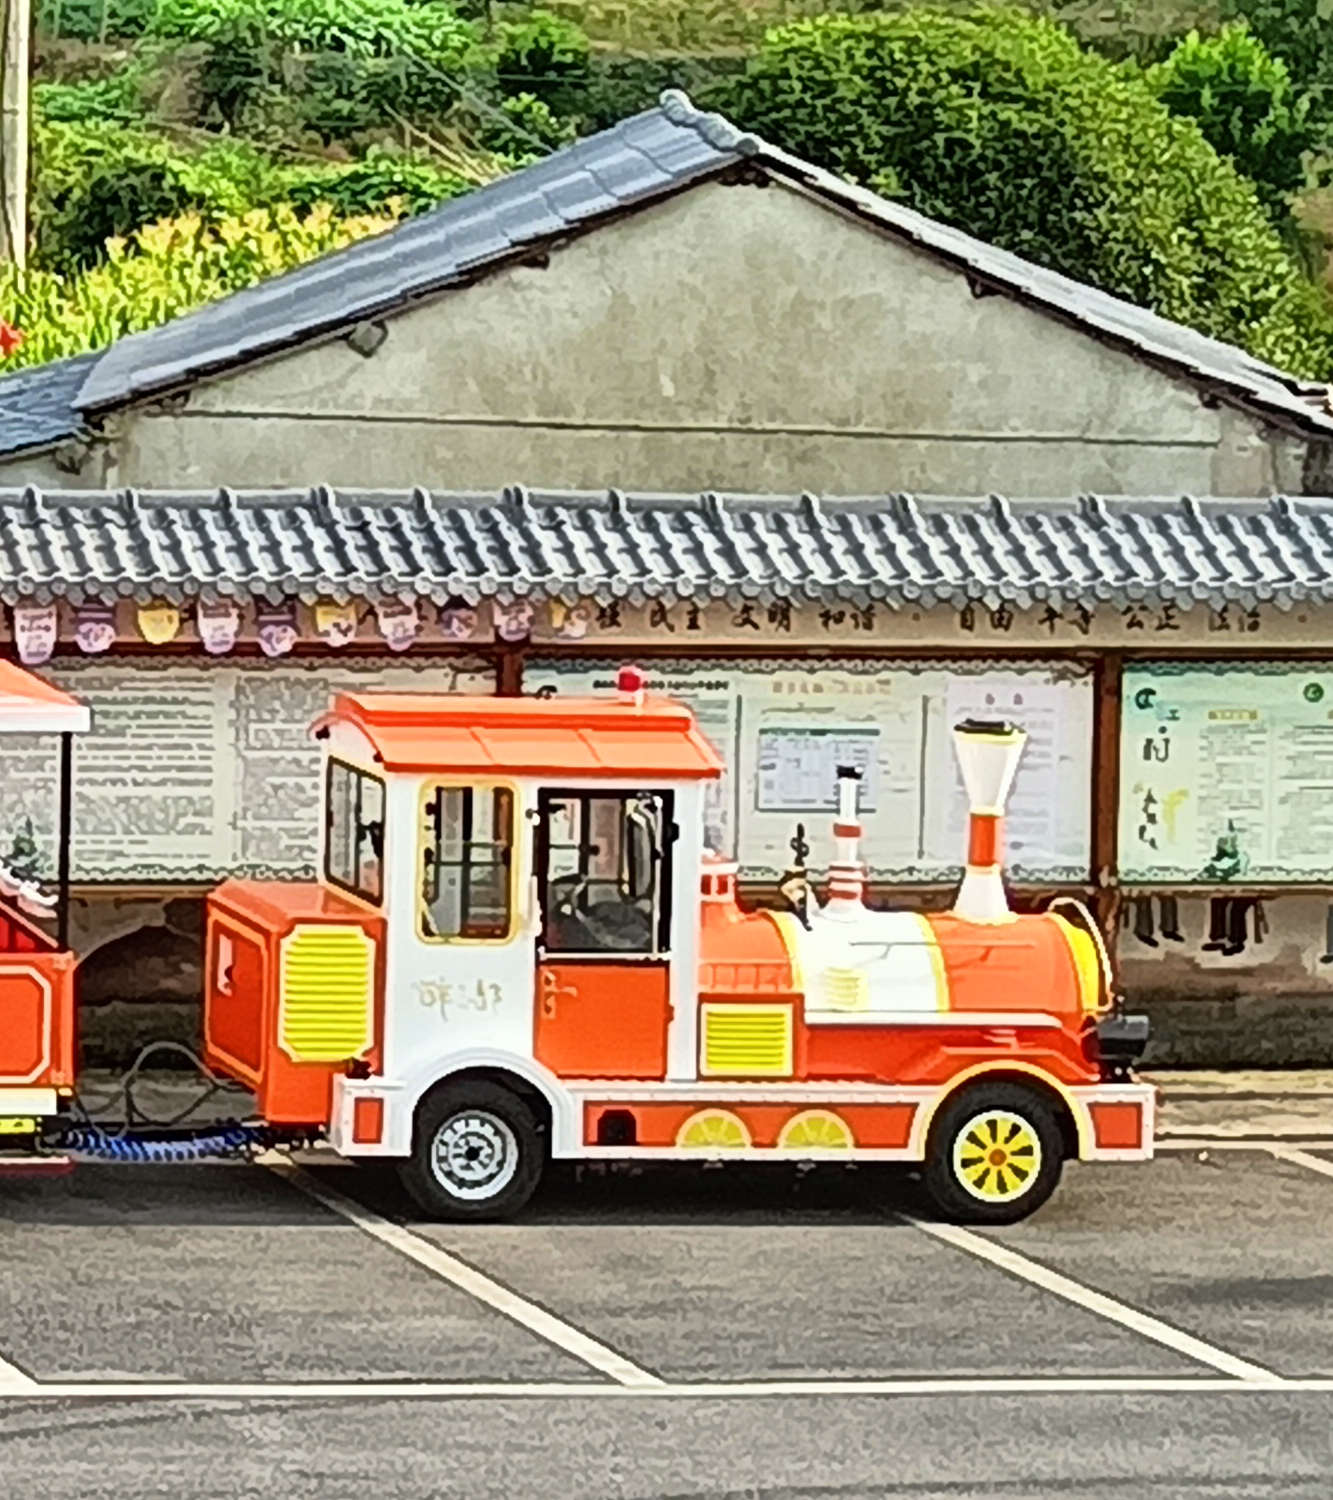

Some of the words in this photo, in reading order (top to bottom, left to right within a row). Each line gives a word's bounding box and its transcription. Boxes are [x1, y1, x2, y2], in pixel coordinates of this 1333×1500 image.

[650, 600, 702, 632] 民主
[734, 600, 793, 632] 文明
[819, 603, 876, 632] 和谐
[959, 603, 1014, 632] 自由
[1037, 604, 1096, 635] 平等
[1121, 604, 1180, 632] 公正
[1208, 604, 1261, 632] 法治
